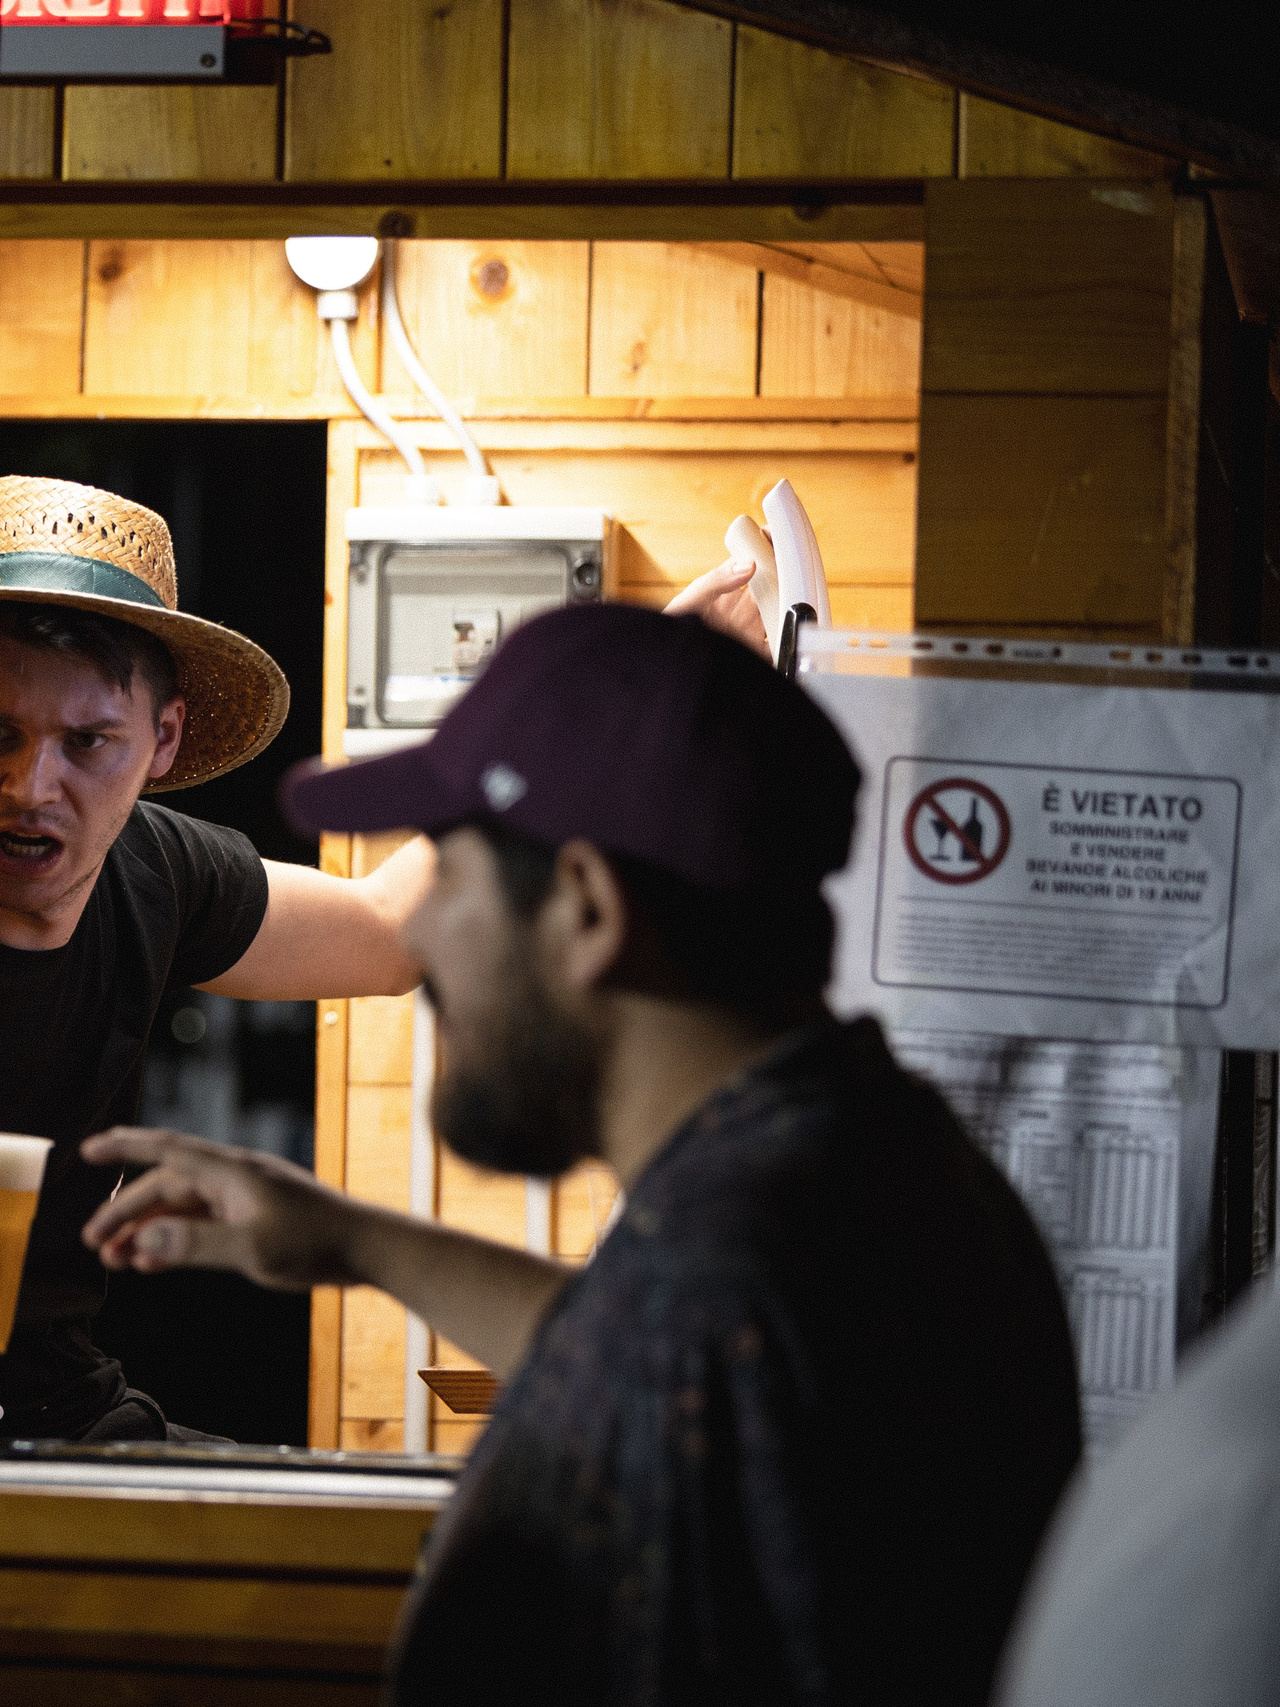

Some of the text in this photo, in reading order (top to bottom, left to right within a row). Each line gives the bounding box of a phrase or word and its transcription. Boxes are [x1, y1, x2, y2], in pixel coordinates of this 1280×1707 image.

[1041, 781, 1203, 822] È VIETATO
[1049, 820, 1190, 845] SOMMINISTRARE
[1071, 842, 1166, 863] E VENDERE
[1025, 858, 1209, 885] BEVANDE ALCOLICHE
[1031, 879, 1203, 903] AI MINORI DI 18 ANNI
